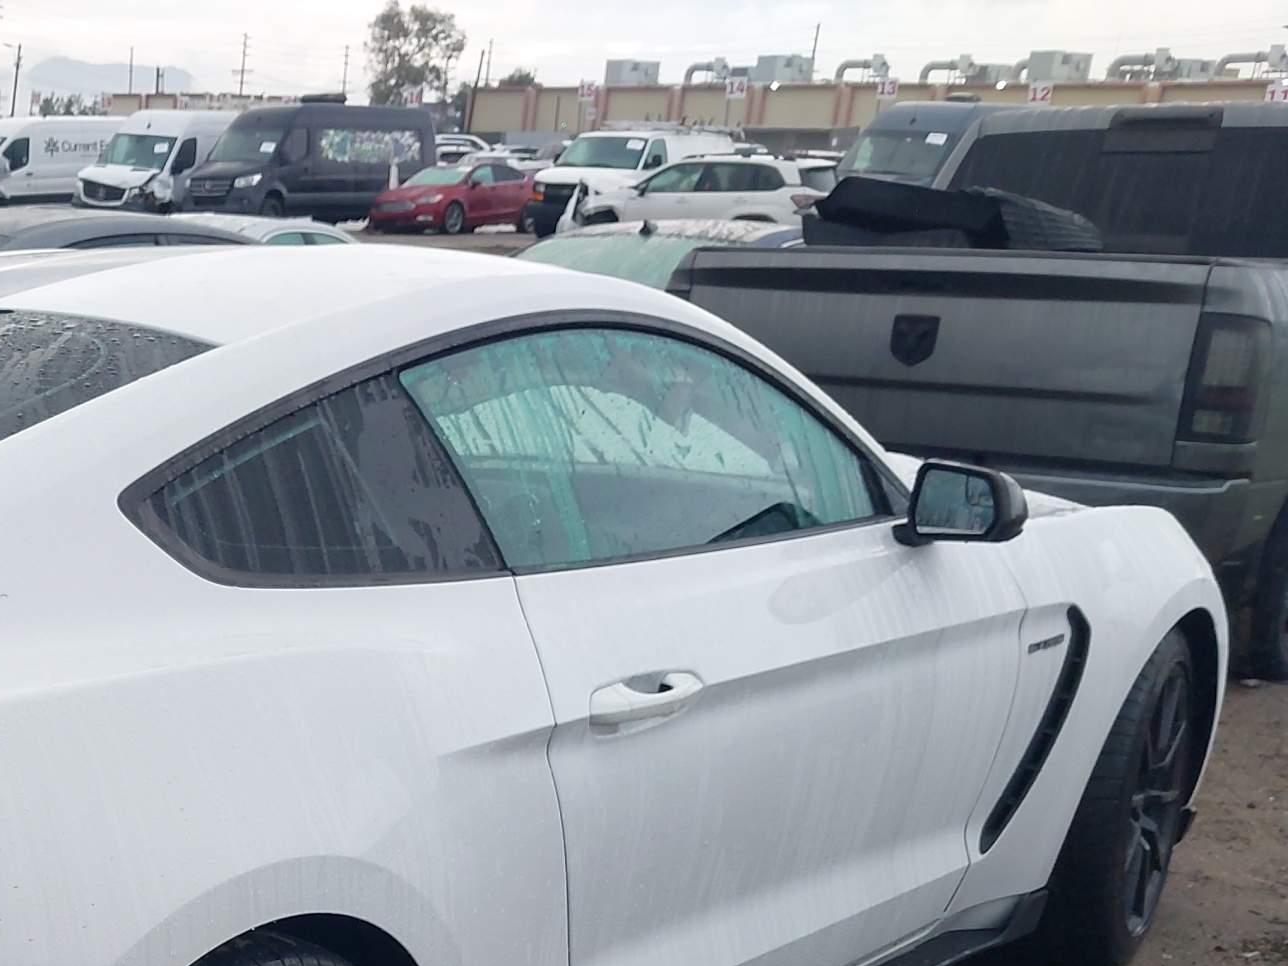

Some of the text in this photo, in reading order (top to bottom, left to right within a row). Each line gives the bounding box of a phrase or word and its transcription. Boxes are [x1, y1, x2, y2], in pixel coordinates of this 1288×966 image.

[729, 81, 745, 95] 14
[878, 80, 896, 95] 13
[1031, 86, 1050, 102] 12
[61, 140, 97, 153] Current
